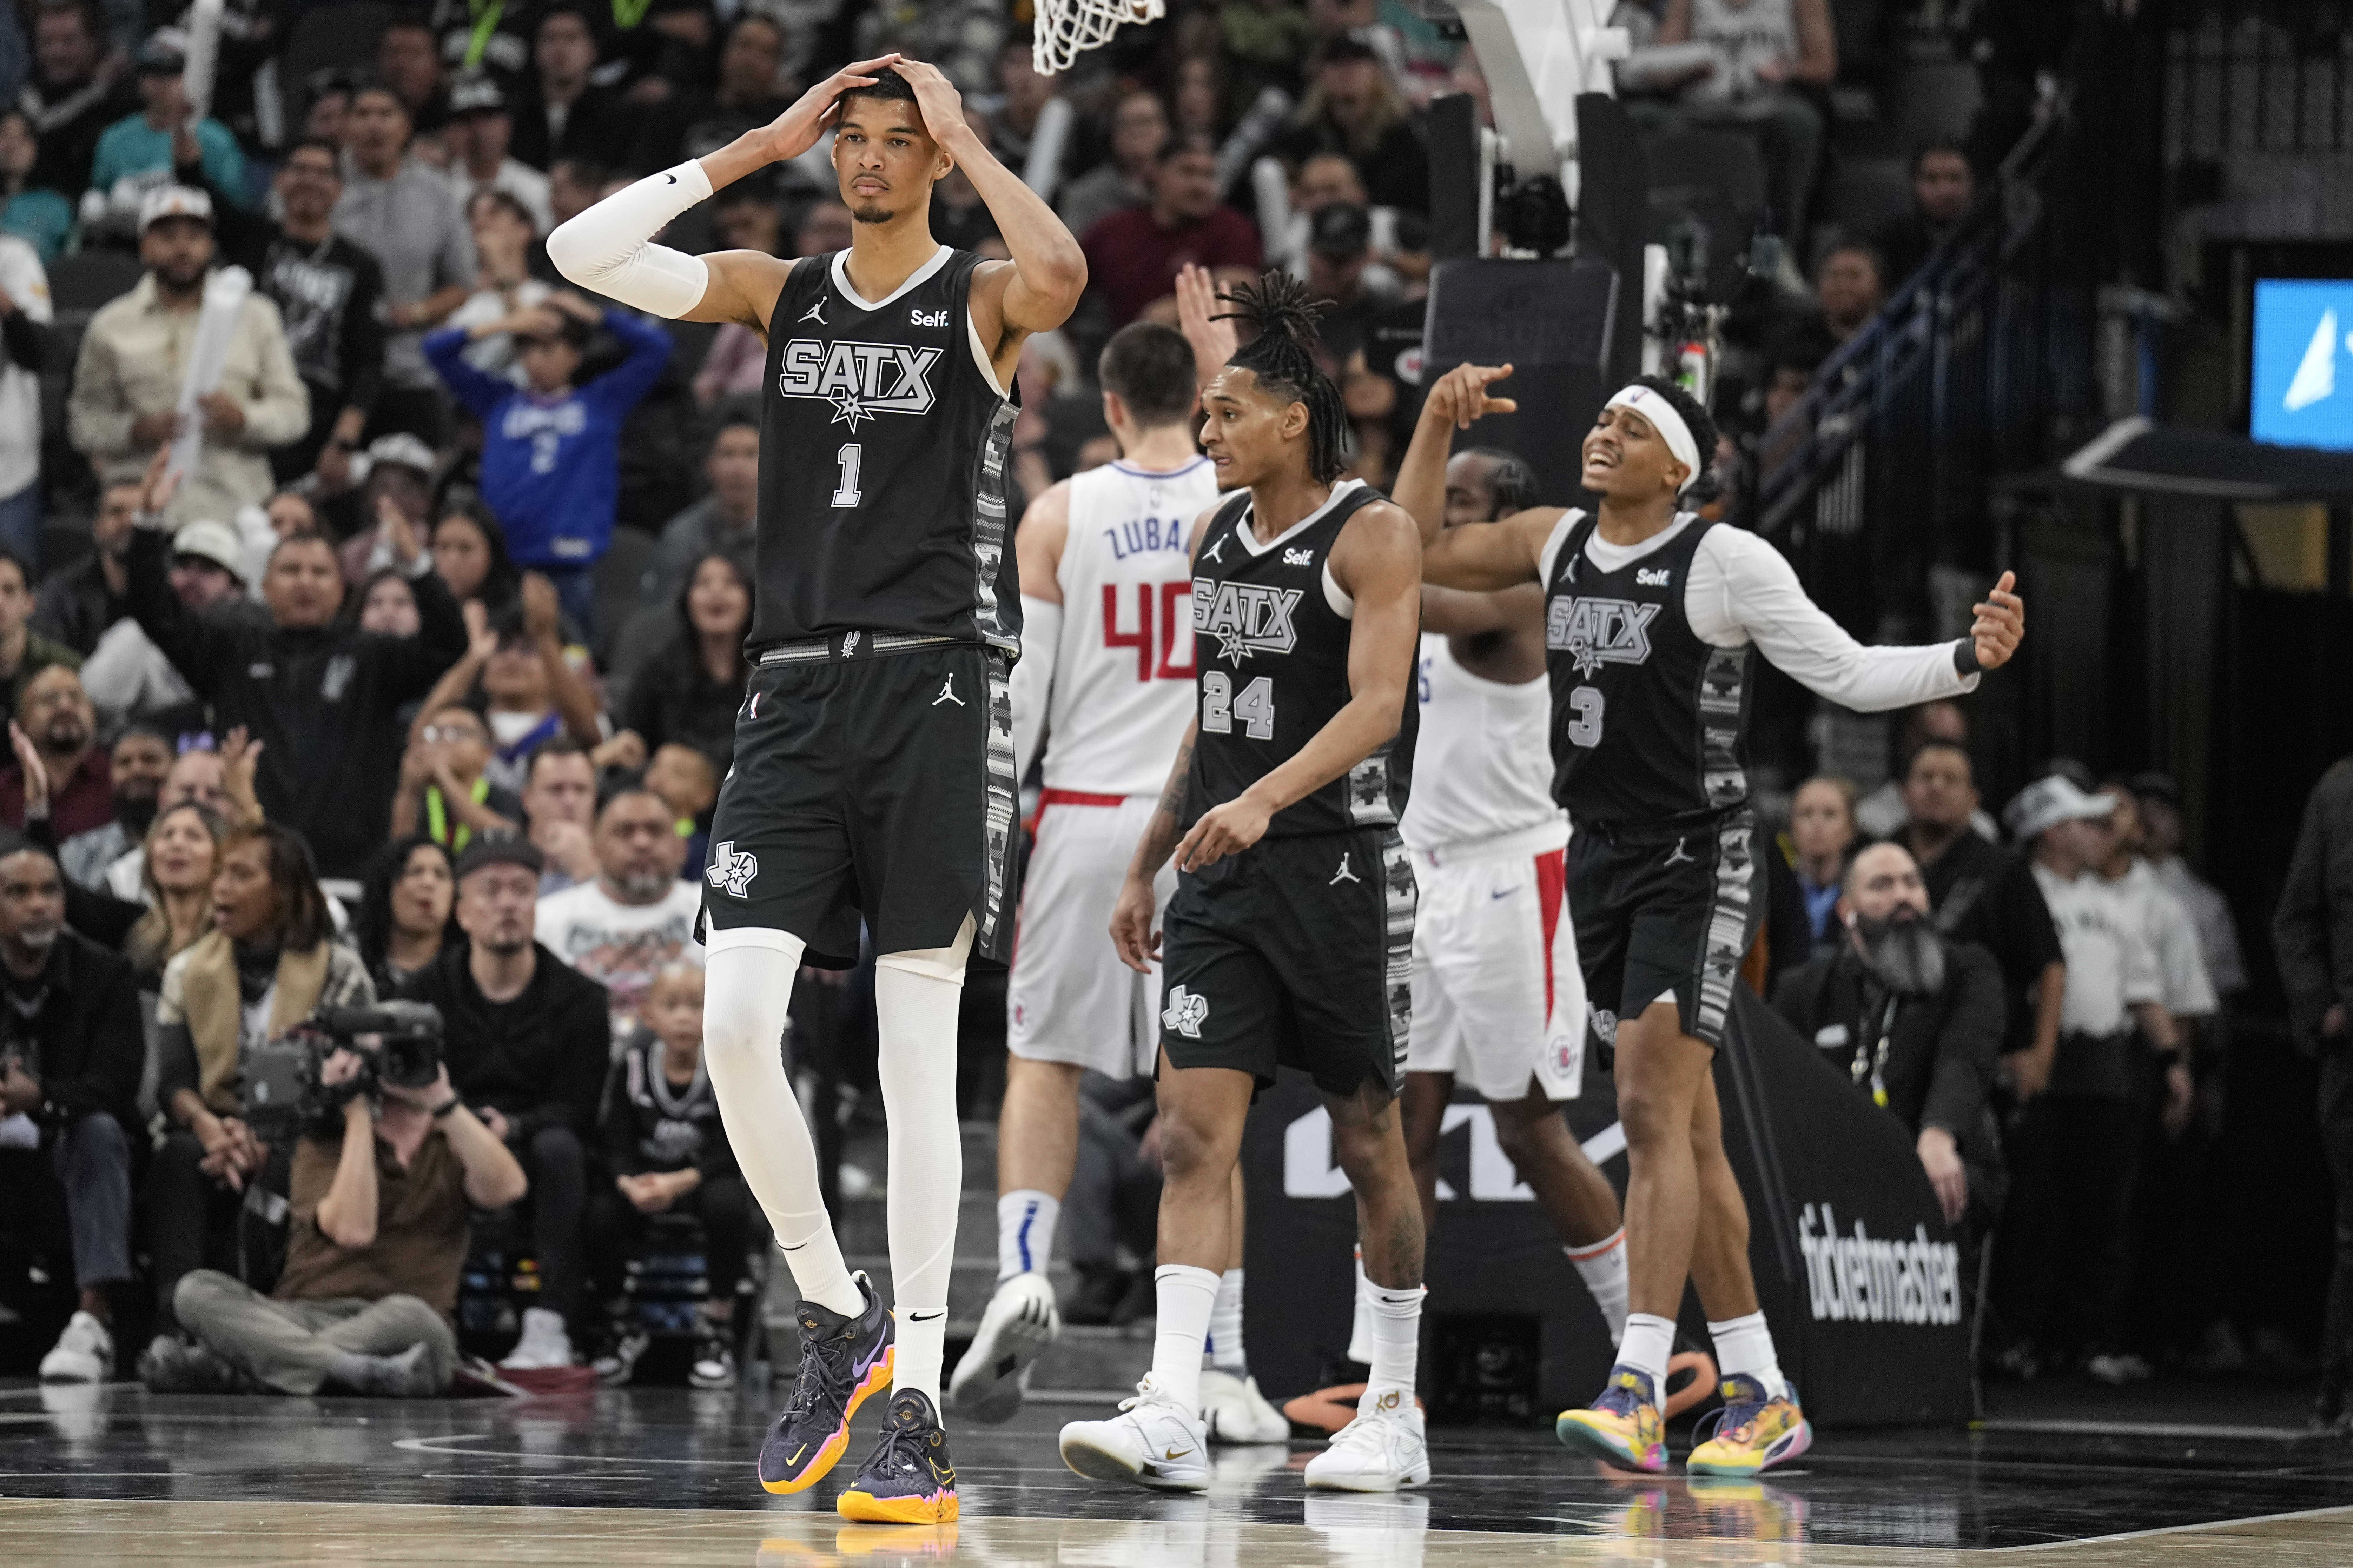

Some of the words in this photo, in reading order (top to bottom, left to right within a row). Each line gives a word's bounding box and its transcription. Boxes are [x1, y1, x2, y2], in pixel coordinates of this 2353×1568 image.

[779, 338, 944, 416] SATX
[831, 443, 861, 507] 1
[1103, 517, 1190, 560] ZUBA
[1102, 581, 1197, 683] 40
[1191, 577, 1305, 655] SATX
[1546, 594, 1663, 666] SATX
[1202, 670, 1275, 740] 24
[1568, 685, 1605, 749] 3
[1798, 1202, 1962, 1326] ticketmaster
